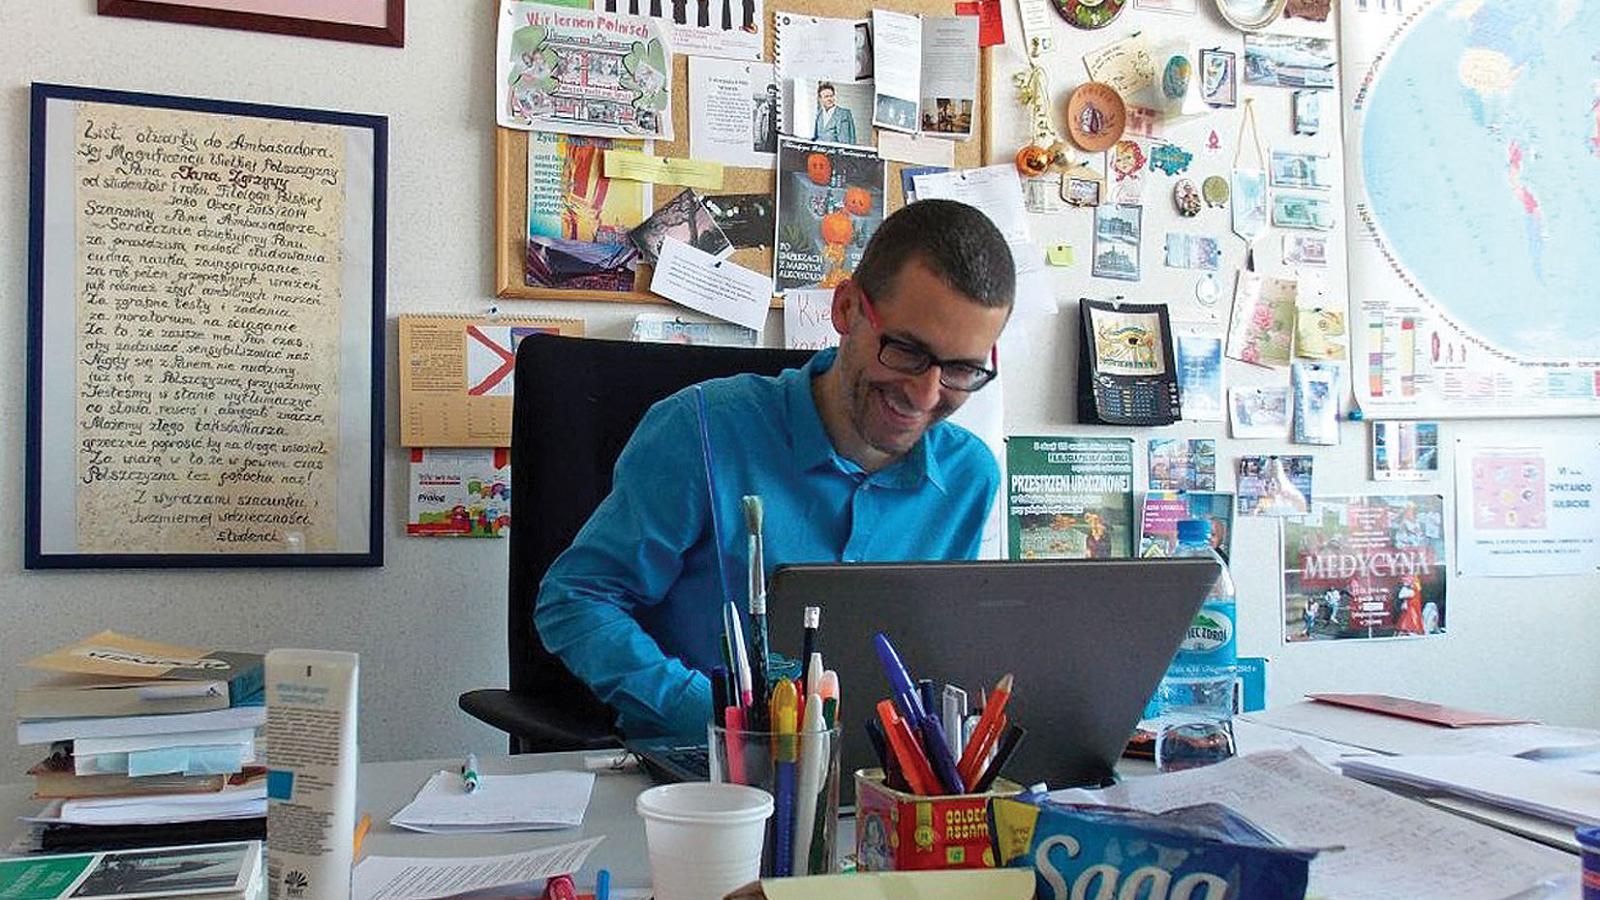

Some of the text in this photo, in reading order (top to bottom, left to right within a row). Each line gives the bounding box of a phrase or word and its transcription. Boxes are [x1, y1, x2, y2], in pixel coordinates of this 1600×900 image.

[526, 11, 650, 38] Wir lernen Polnisch
[203, 130, 222, 148] do
[1303, 550, 1431, 580] MEDYCYNA
[945, 822, 989, 841] ASSAM
